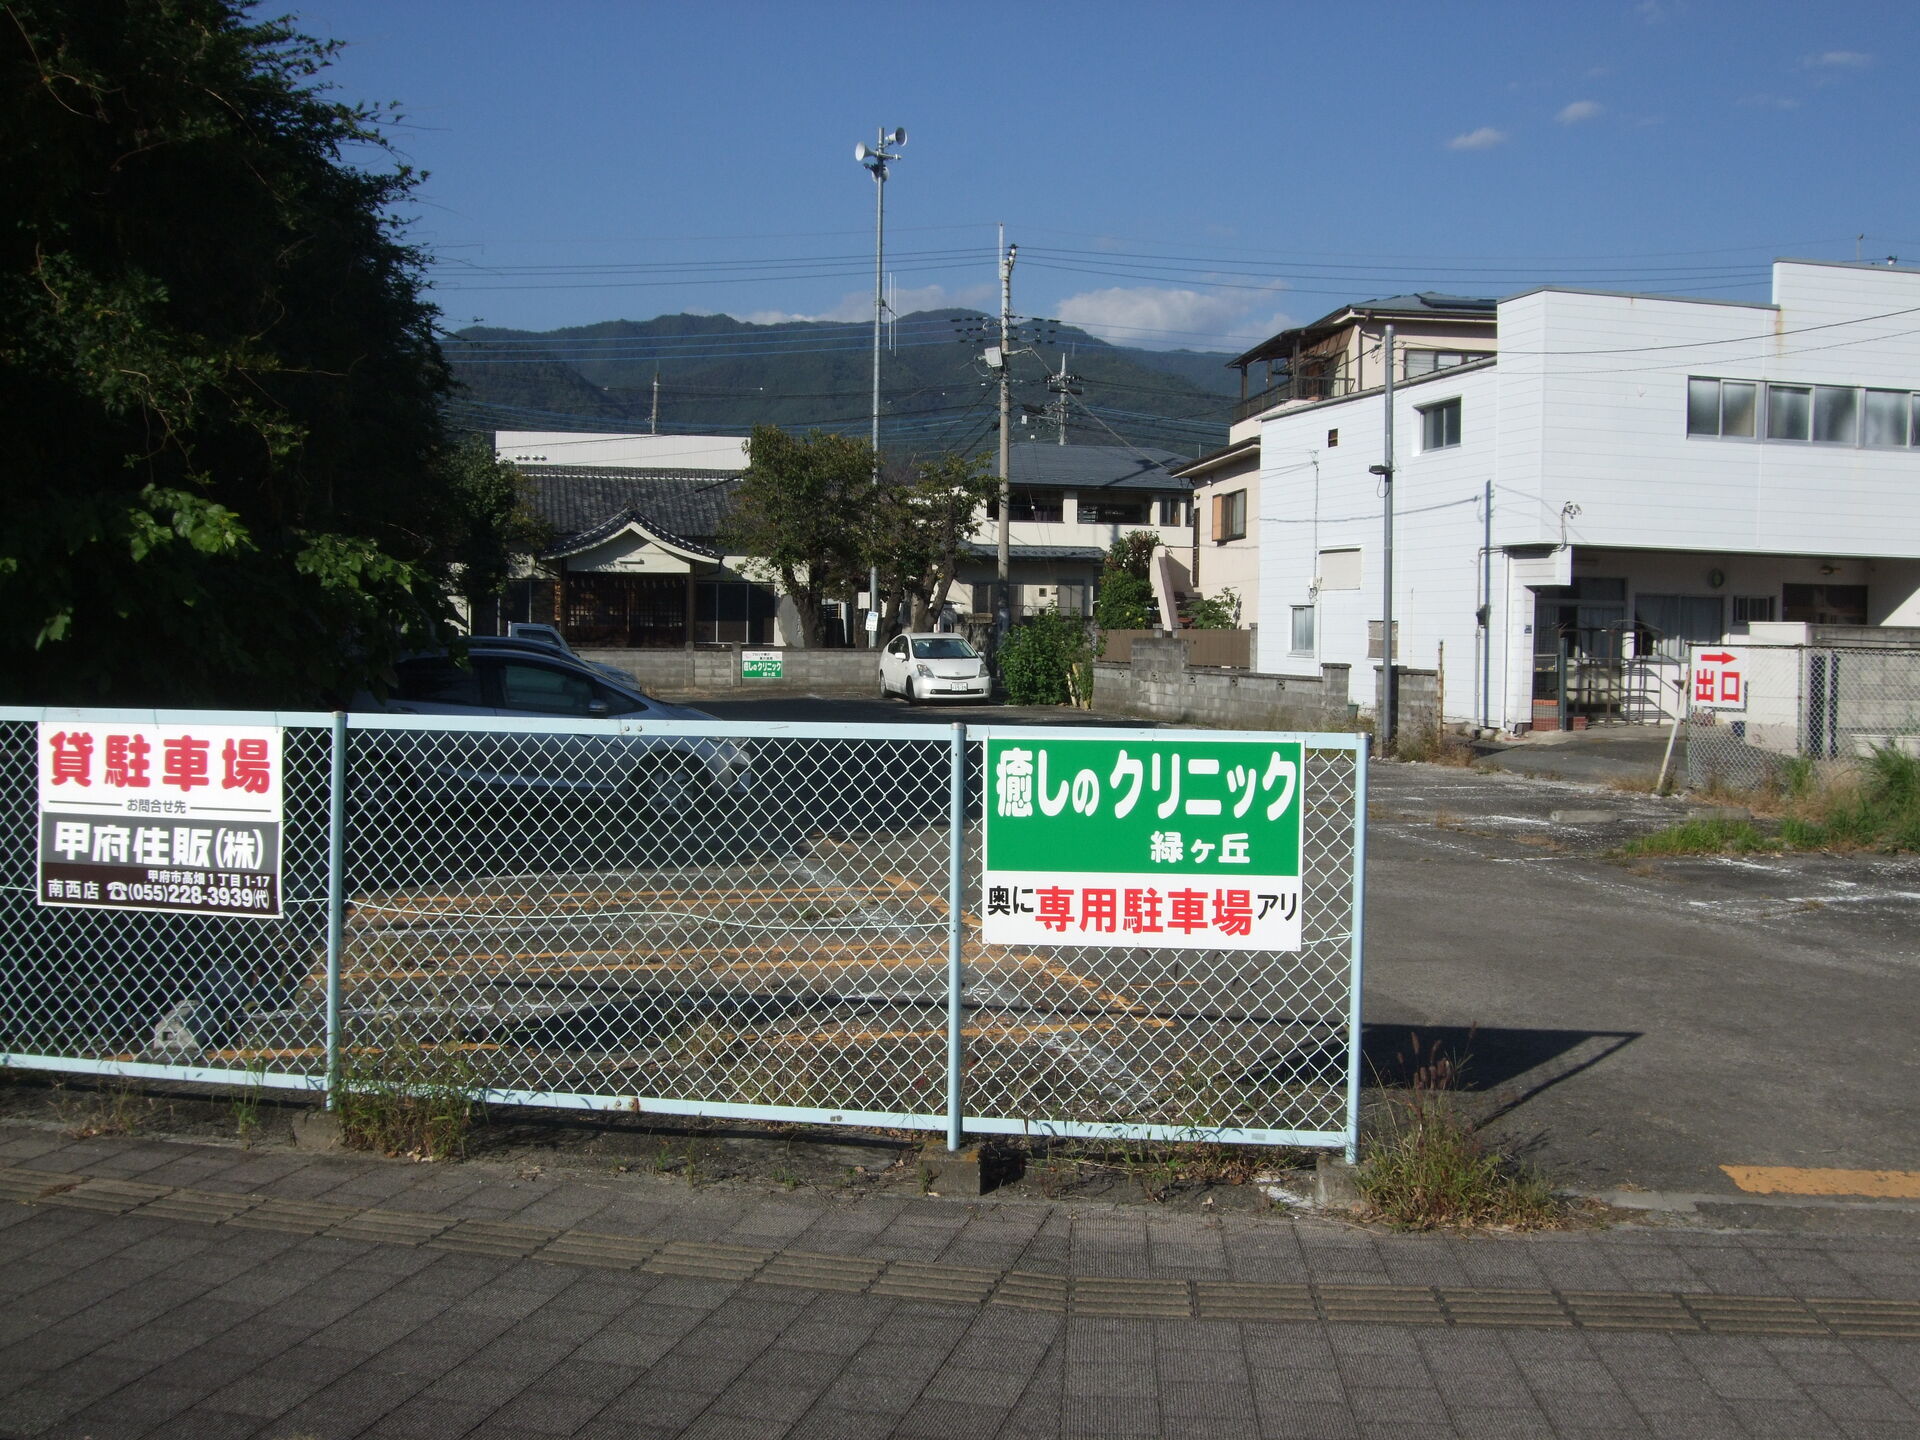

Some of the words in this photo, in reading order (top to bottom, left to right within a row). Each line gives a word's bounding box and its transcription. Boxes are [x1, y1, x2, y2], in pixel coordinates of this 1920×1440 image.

[1696, 669, 1740, 702] 出口
[49, 730, 271, 794] 貸駐車場
[996, 747, 1297, 822] 癒しのクリニック
[127, 799, 187, 814] お問合せ先
[54, 821, 264, 870] 甲府住販(株)
[1150, 831, 1250, 864] 緑ヶ丘
[47, 879, 100, 900] 南西店
